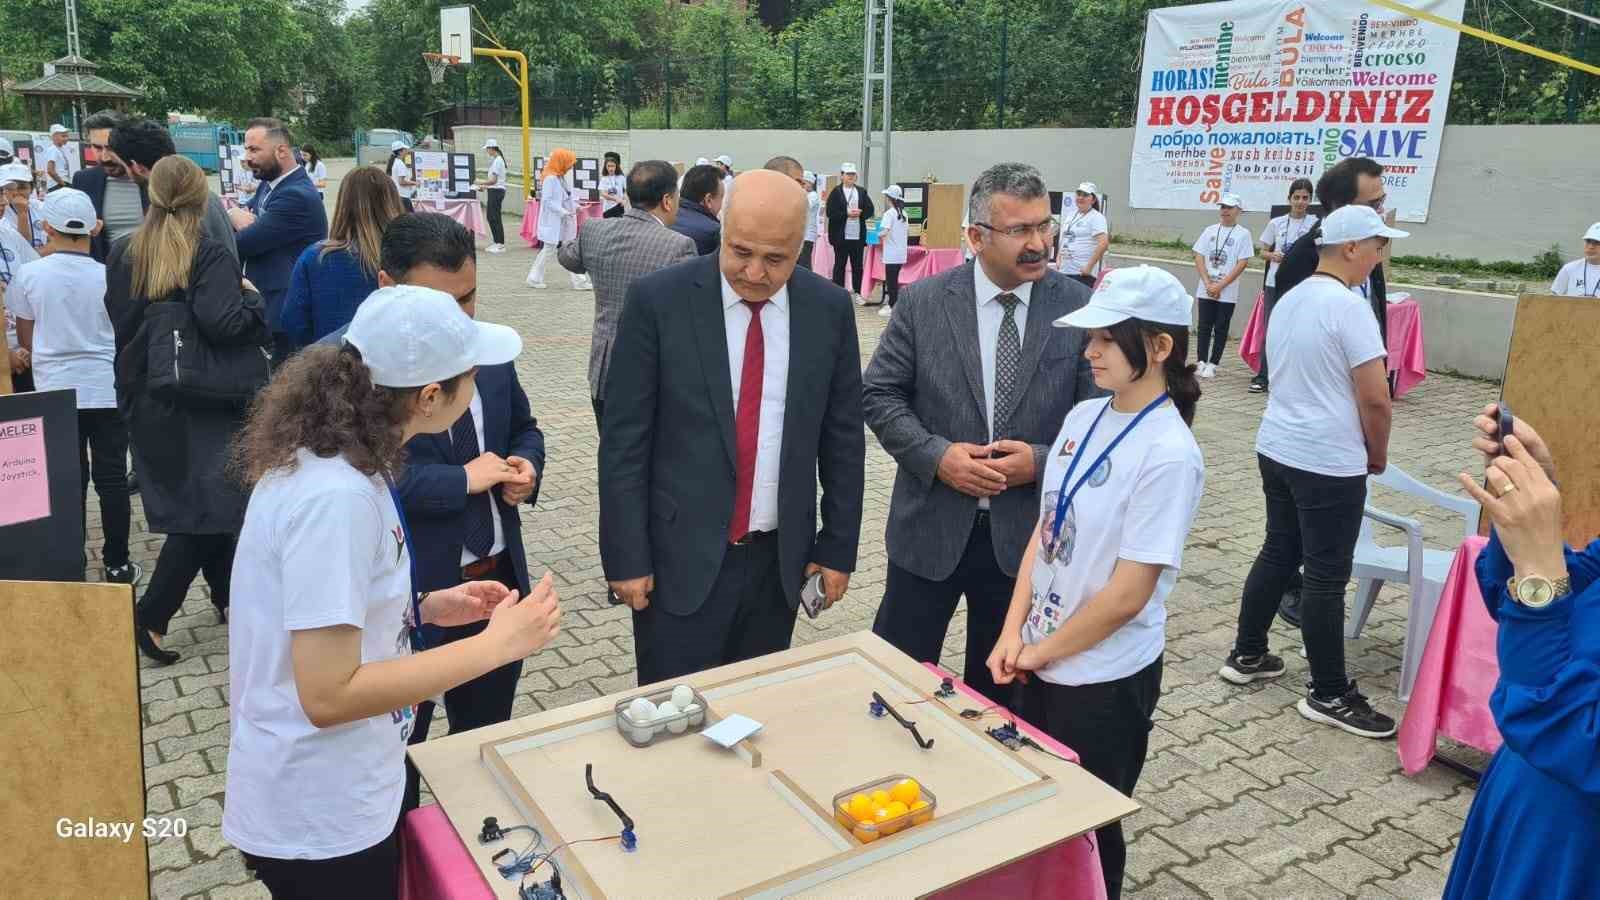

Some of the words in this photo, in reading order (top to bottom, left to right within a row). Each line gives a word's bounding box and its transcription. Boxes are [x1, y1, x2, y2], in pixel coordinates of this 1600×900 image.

[1280, 7, 1305, 87] BULA
[1305, 33, 1345, 42] Welcome
[1215, 20, 1234, 89] merhbe
[1152, 67, 1216, 92] HORAS!
[1228, 70, 1271, 91] Bula
[1352, 71, 1438, 87] Welcome
[1147, 89, 1434, 132] HOŞGELDİNİZ
[1150, 130, 1203, 149] добро
[1208, 128, 1323, 147] пожаловать!
[1338, 128, 1427, 158] SALVE
[1164, 147, 1206, 159] merhbe
[1200, 148, 1226, 203] Salve
